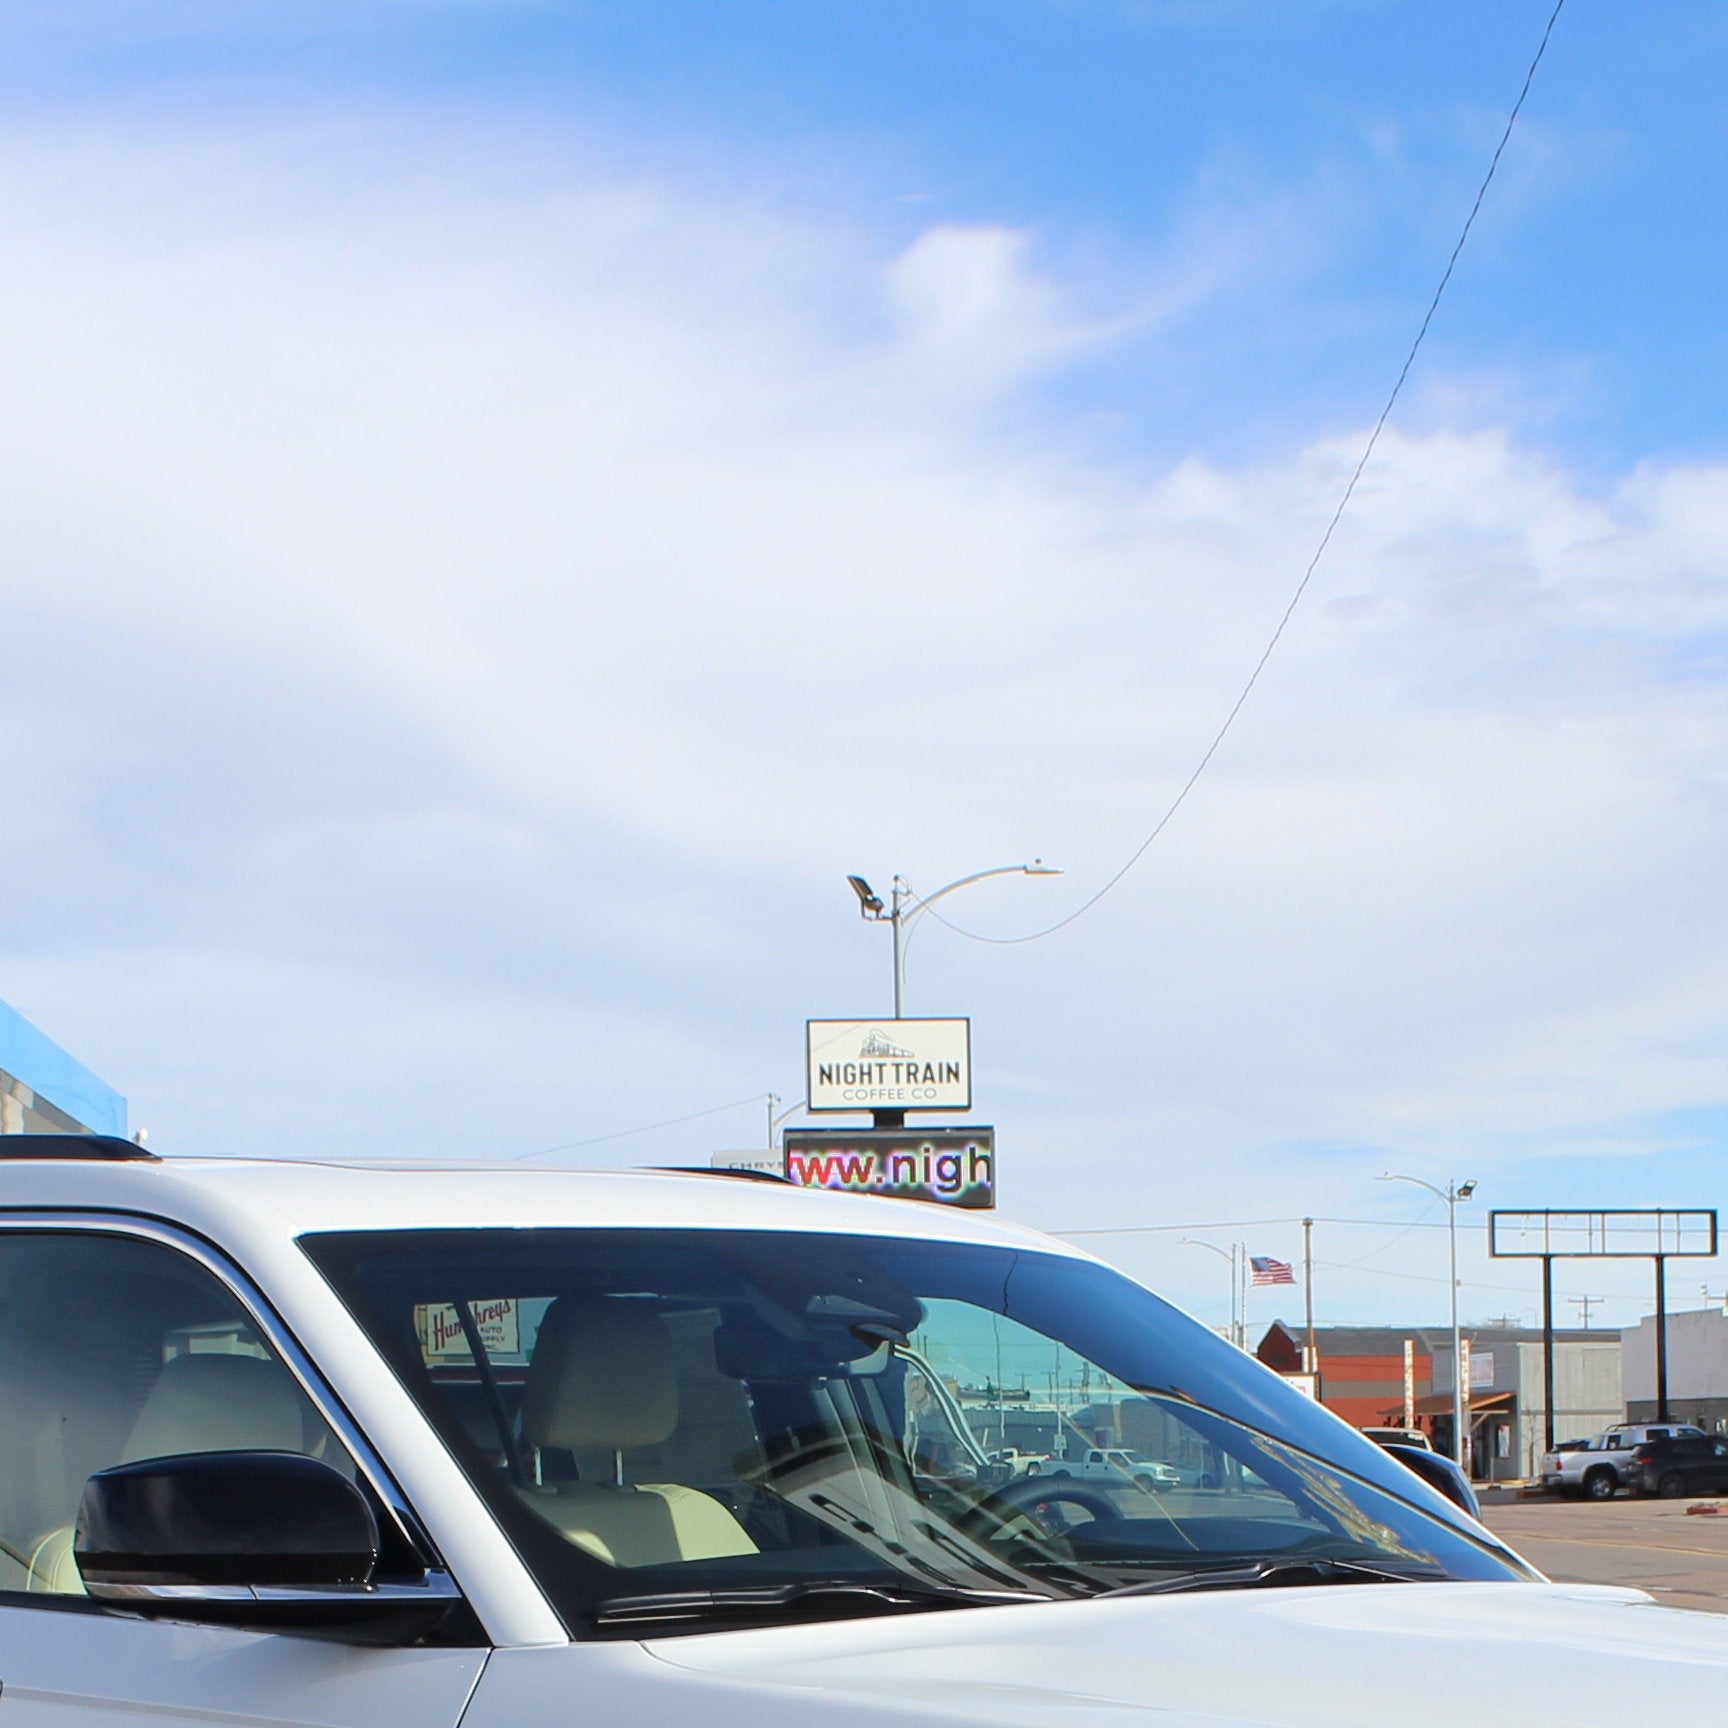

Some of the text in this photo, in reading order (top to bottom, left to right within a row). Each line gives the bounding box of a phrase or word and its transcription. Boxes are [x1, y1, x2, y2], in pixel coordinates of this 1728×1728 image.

[819, 1061, 960, 1086] NIGHT TRAIN
[843, 1088, 937, 1100] COFFEE CO
[434, 1300, 511, 1351] Humhreys
